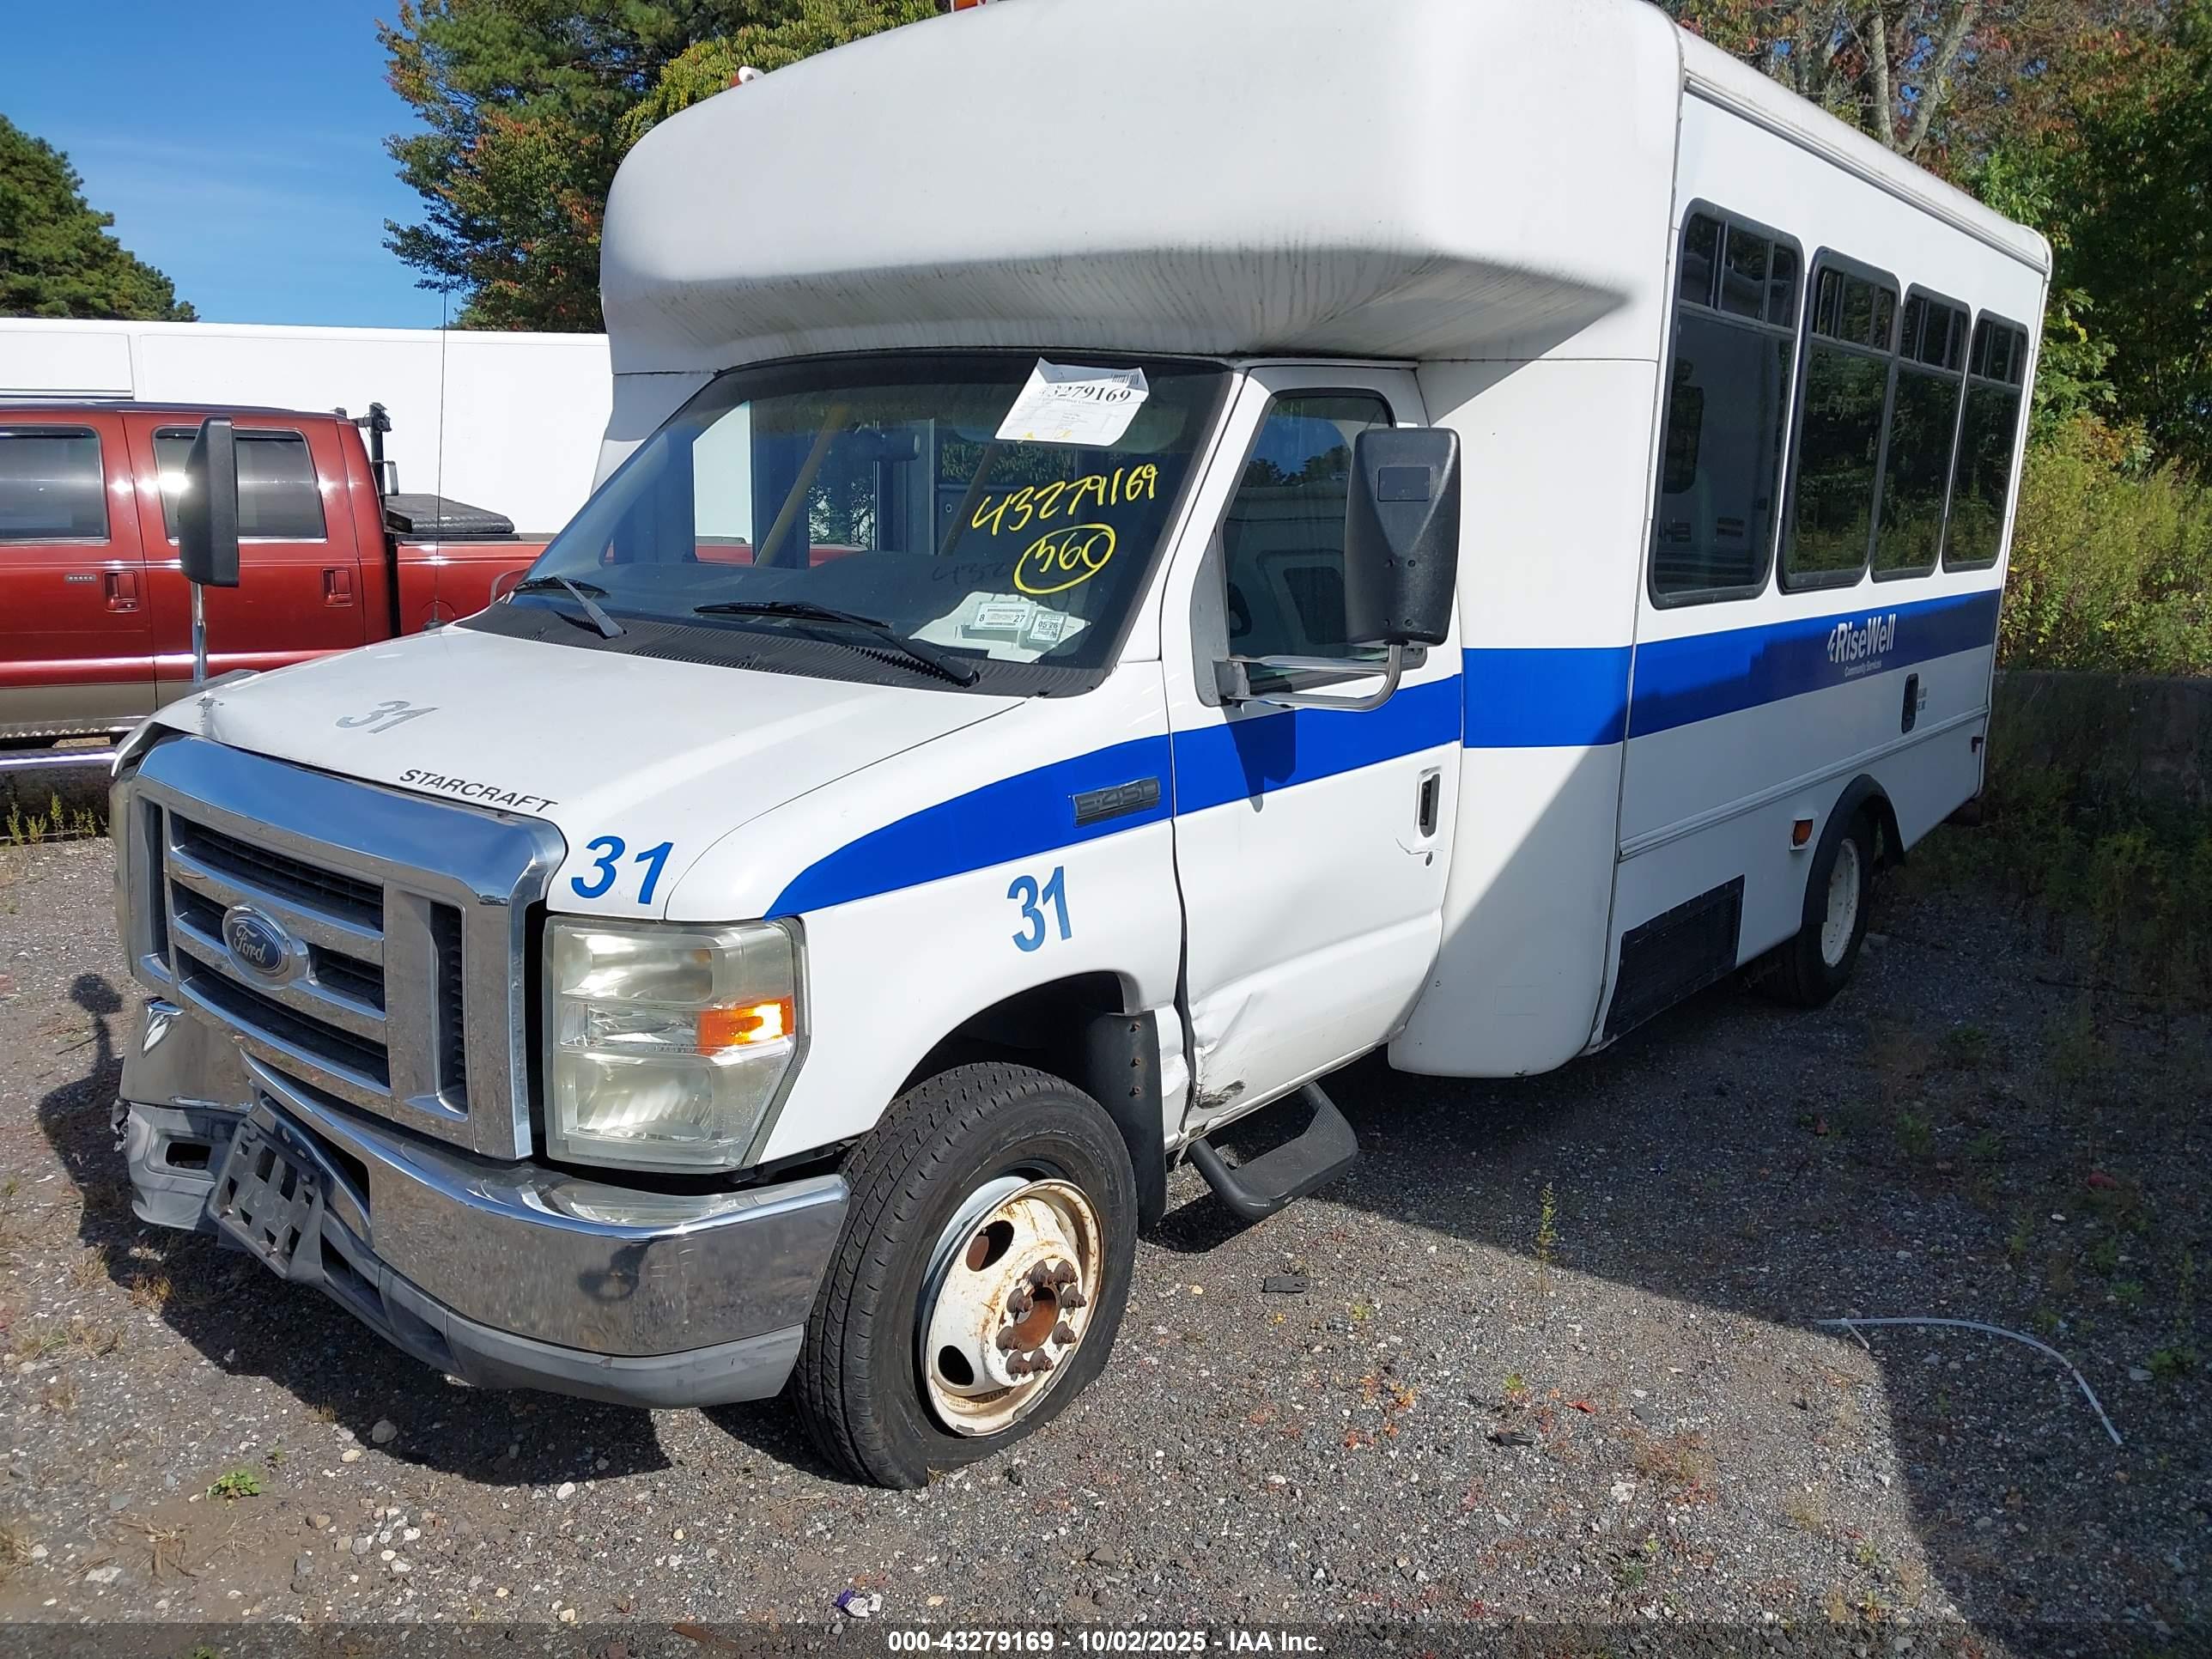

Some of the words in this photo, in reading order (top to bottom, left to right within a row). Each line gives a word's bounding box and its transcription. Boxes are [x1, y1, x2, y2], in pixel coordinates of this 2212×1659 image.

[1039, 384, 1132, 403] 279169
[971, 463, 1158, 536] 43279169
[1013, 614, 1026, 623] 27
[1834, 613, 1897, 664] RiseWell
[335, 700, 440, 734] 31
[398, 769, 559, 813] STARCRAFT
[570, 835, 675, 906] 31
[1006, 865, 1073, 953] 31
[233, 924, 267, 963] Ford
